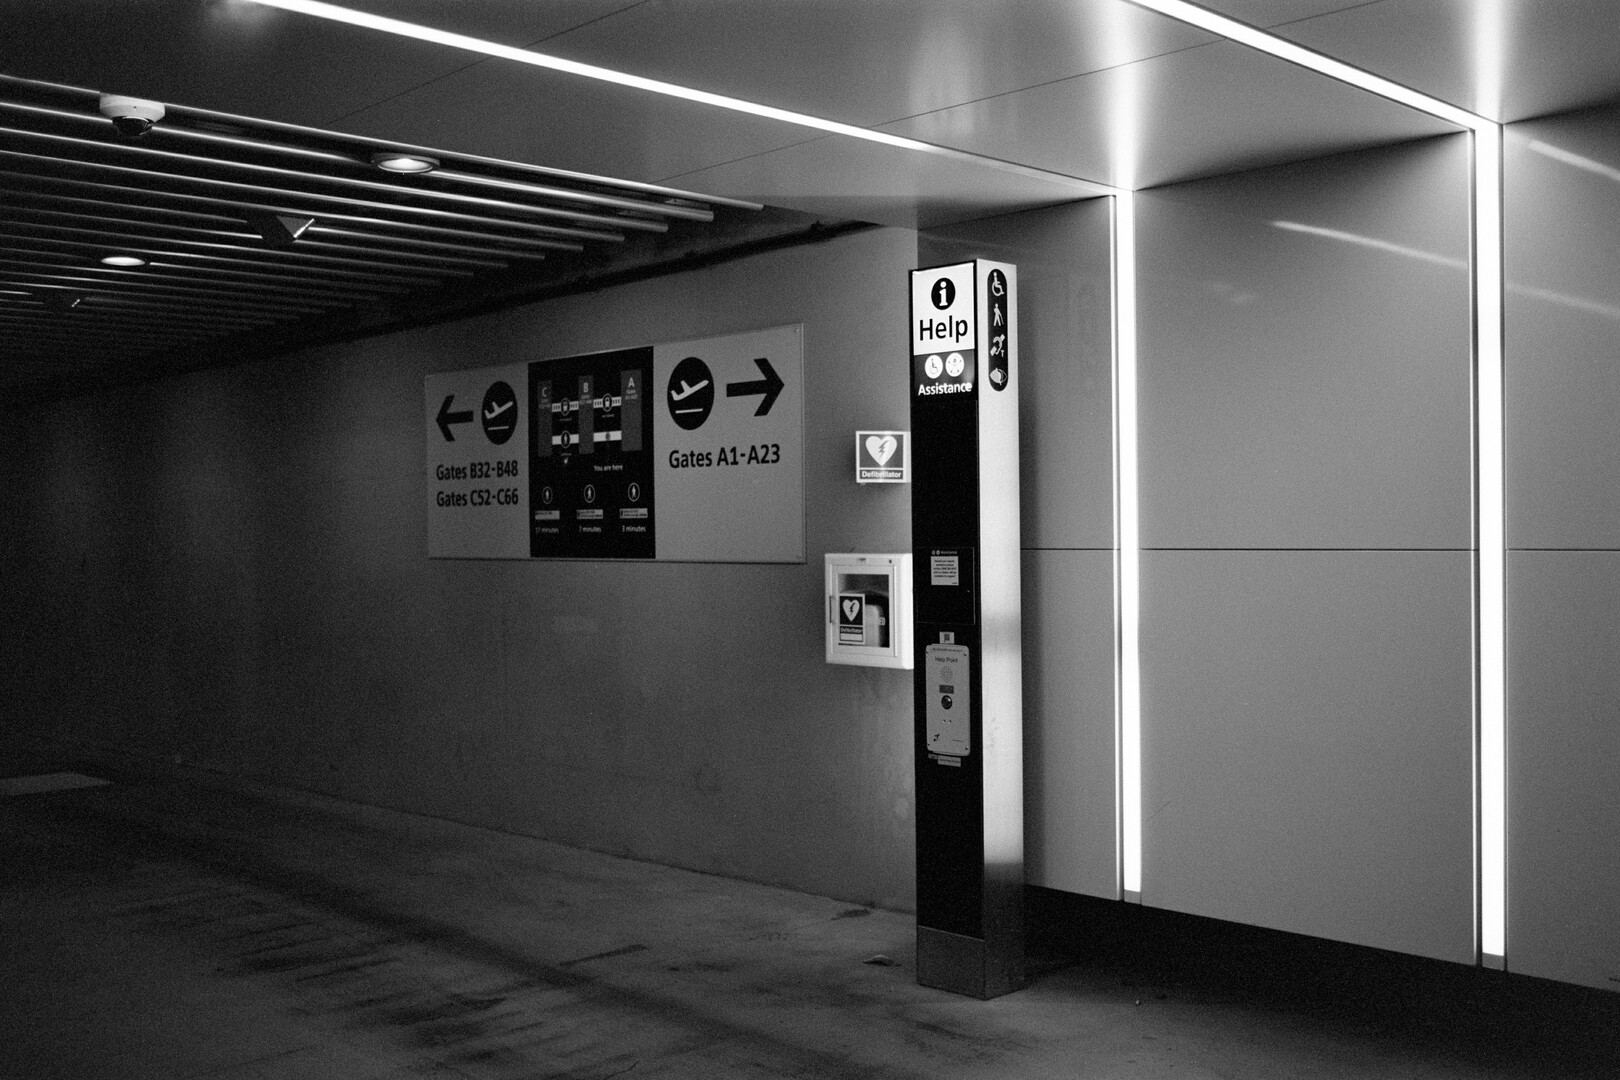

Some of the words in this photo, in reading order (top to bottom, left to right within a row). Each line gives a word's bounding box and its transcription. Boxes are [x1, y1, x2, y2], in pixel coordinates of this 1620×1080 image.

[919, 315, 969, 343] Help
[582, 382, 590, 393] B
[627, 377, 636, 388] A
[918, 382, 973, 396] Assistance
[668, 450, 713, 469] Gates
[716, 443, 780, 467] A1-A23
[436, 464, 467, 480] Gates
[470, 460, 519, 479] B32-B48
[861, 470, 902, 478] Defibrillator
[436, 491, 468, 507] Gates
[470, 488, 519, 506] C52-C66
